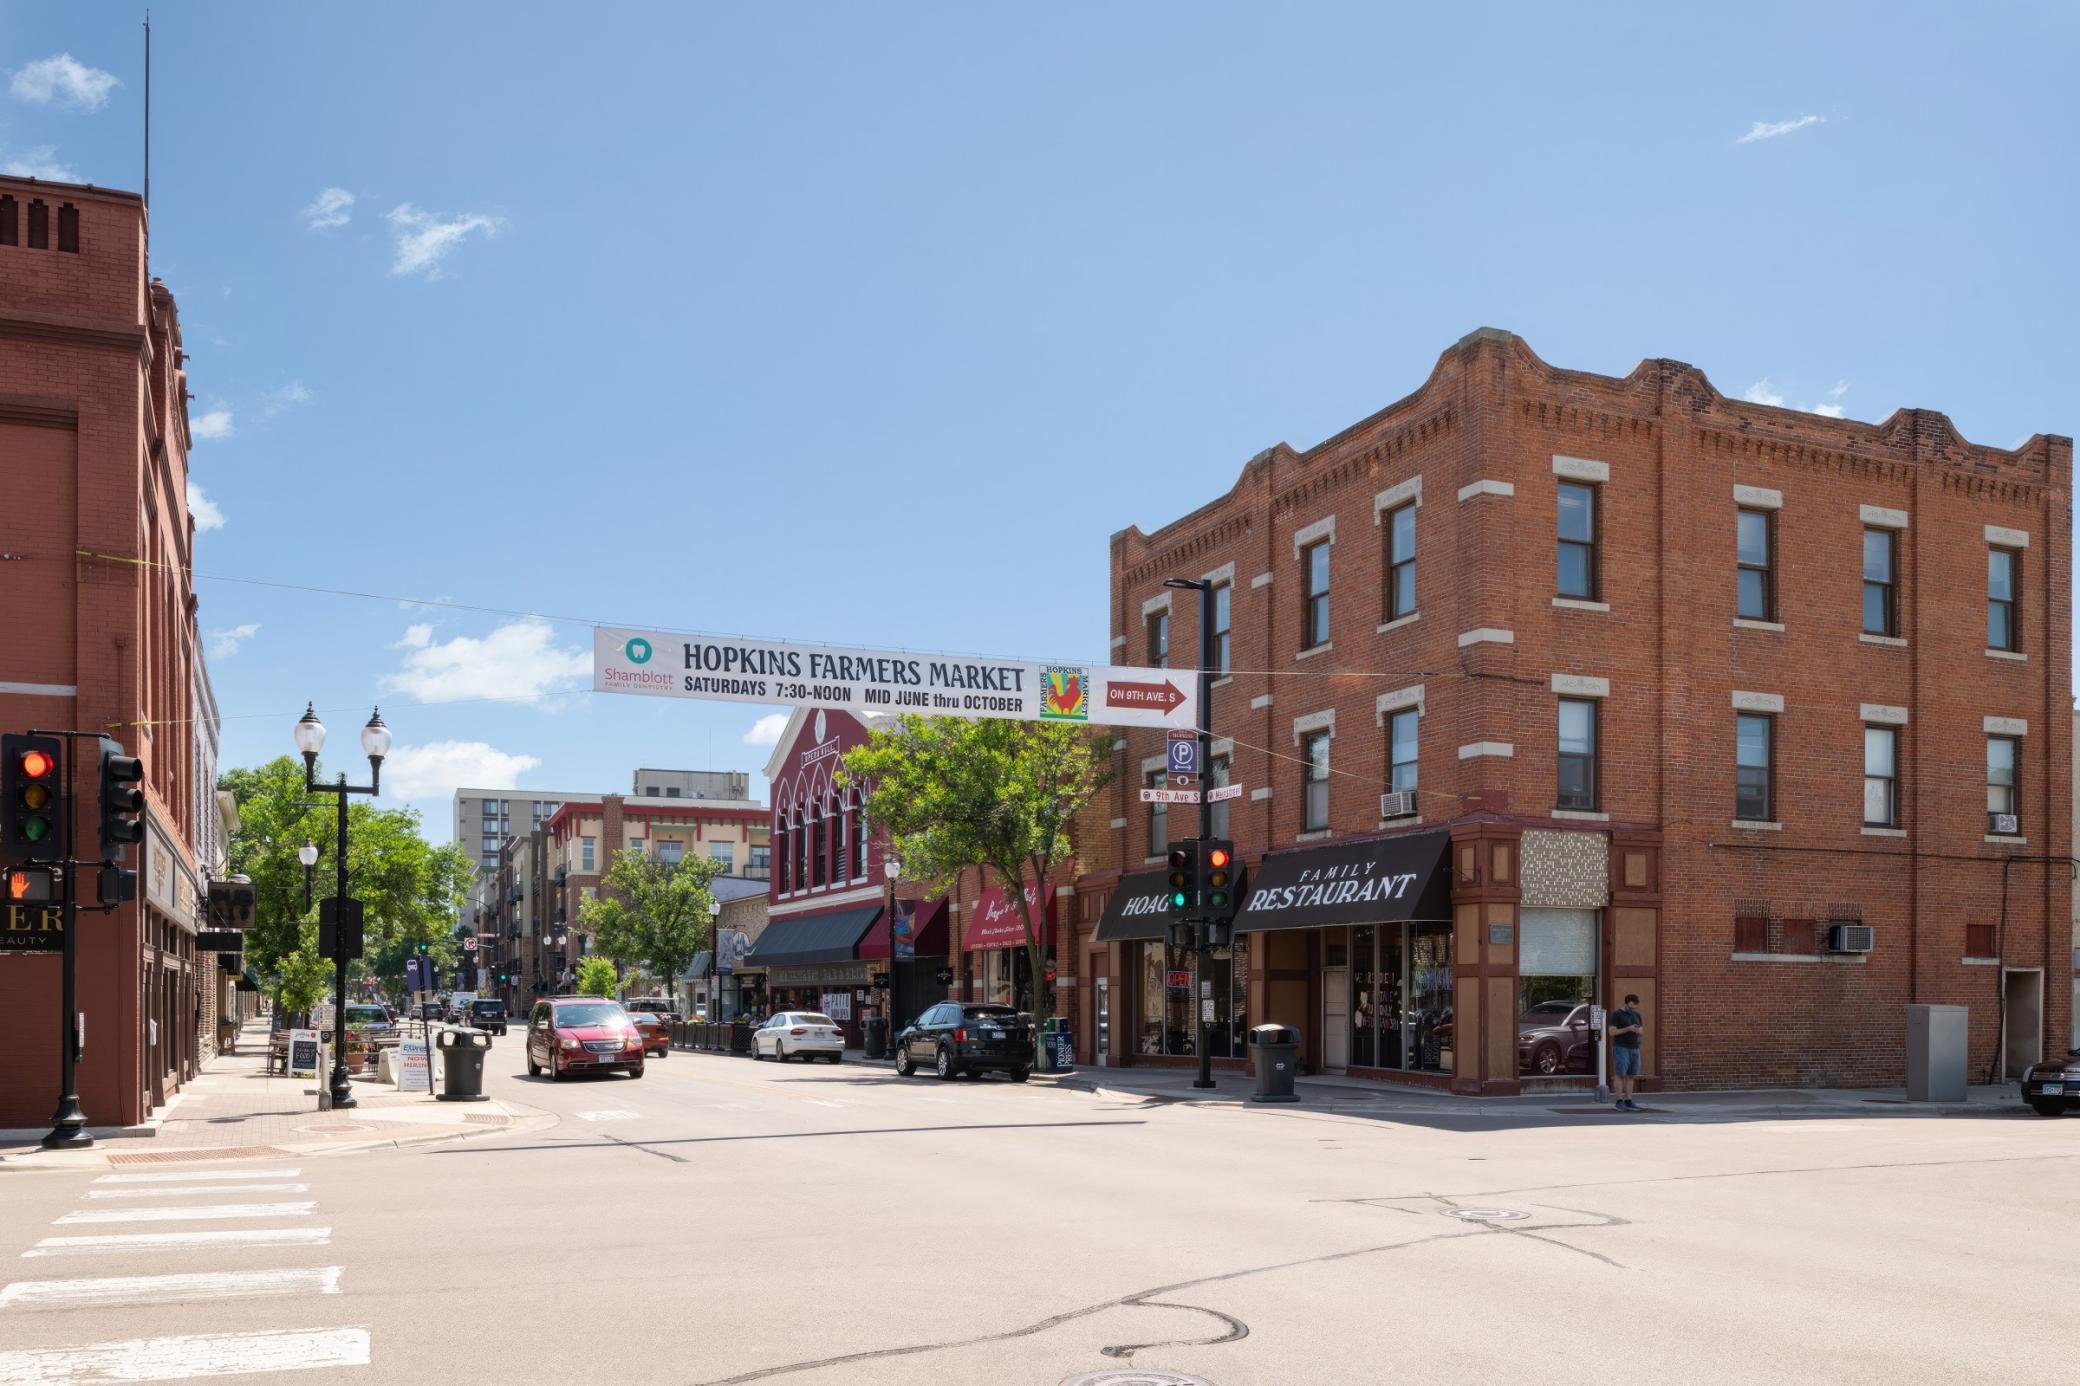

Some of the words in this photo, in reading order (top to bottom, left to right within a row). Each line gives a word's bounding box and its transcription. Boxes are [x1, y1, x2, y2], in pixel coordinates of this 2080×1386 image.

[605, 667, 673, 684] Shamblott
[683, 643, 801, 677] HOPKINS
[809, 653, 921, 685] FARMERS
[929, 662, 1025, 692] MARKET
[1046, 666, 1083, 675] HOPKINS
[605, 681, 630, 689] FAMILY
[633, 683, 673, 691] DENTISTRY
[684, 676, 766, 696] SATURDAYS
[775, 682, 851, 702] 7:30-NOON
[864, 688, 891, 704] MID
[895, 690, 929, 707] JUNE
[933, 693, 959, 709] thru
[964, 695, 1023, 712] OCTOBER
[1040, 672, 1048, 713] FARMERS
[1081, 675, 1089, 715] MARKET
[1110, 689, 1124, 700] ON
[1126, 690, 1144, 701] 9TH
[1146, 691, 1167, 702] AVE.
[1169, 692, 1176, 703] S
[1155, 790, 1170, 800] 9th
[1174, 791, 1189, 802] Ave
[1193, 792, 1199, 802] S
[1299, 861, 1377, 883] FAMILY
[1247, 873, 1417, 912] RESTAURANT
[1168, 972, 1191, 986] OPEN
[403, 1044, 432, 1053] Expres
[1056, 1035, 1065, 1067] PIONEER
[1064, 1044, 1073, 1067] PRESS
